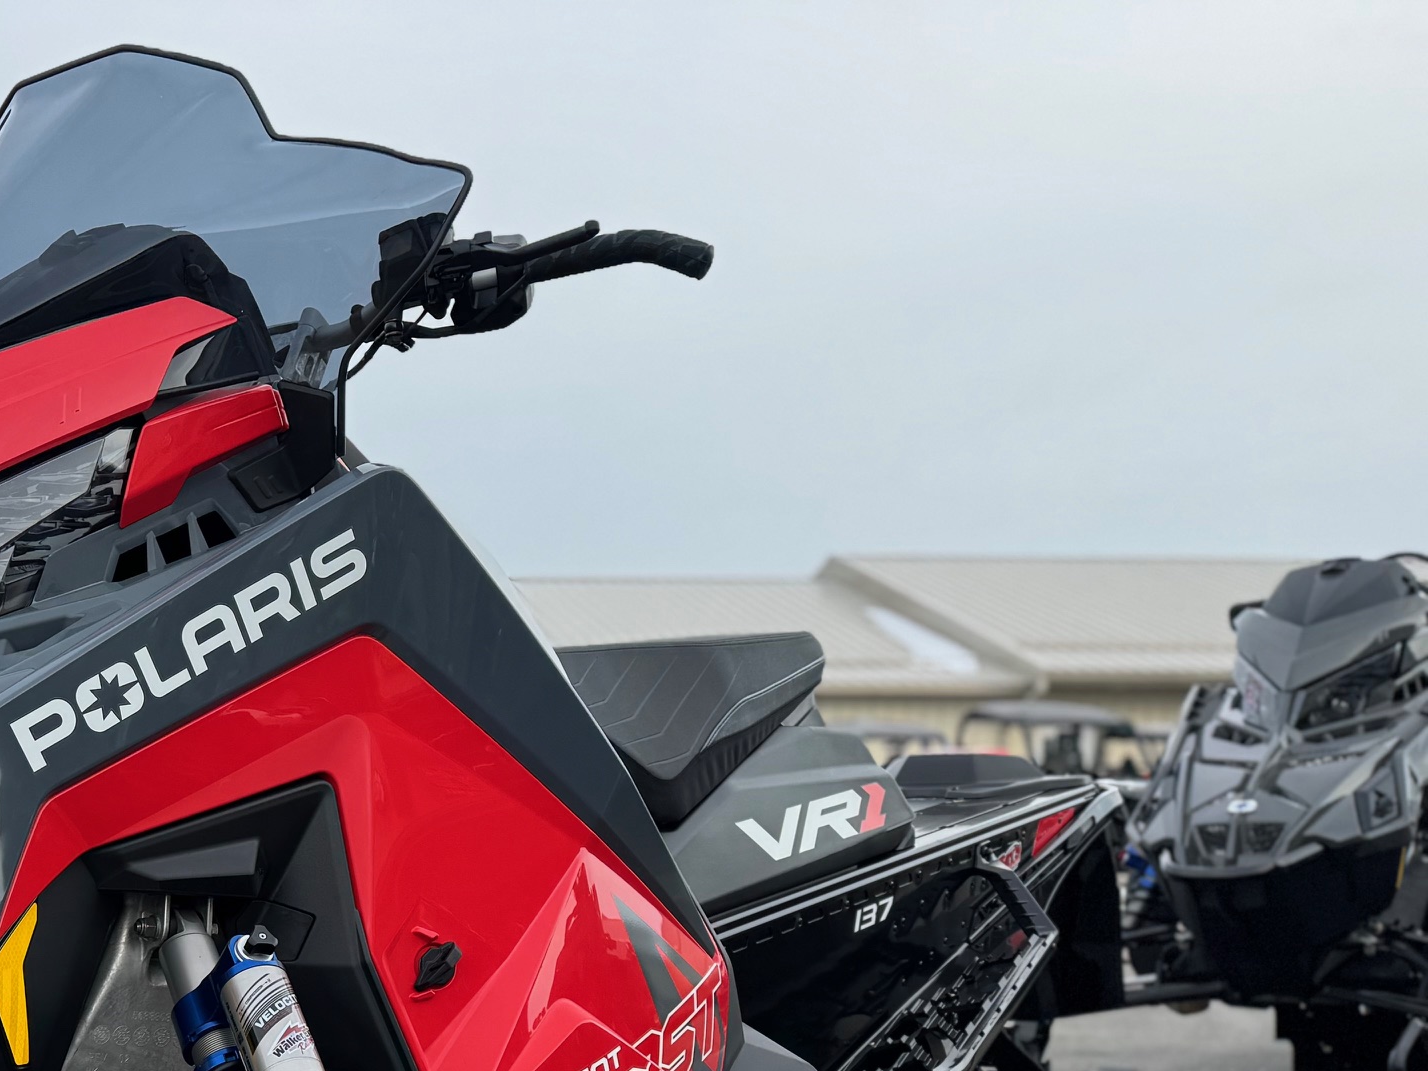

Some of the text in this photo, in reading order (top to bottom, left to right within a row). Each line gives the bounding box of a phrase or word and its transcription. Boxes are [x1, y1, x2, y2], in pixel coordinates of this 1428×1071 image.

[9, 528, 368, 773] POLARIS
[734, 781, 887, 862] VR1
[853, 895, 895, 934] 137
[254, 993, 299, 1029] VELOCIT
